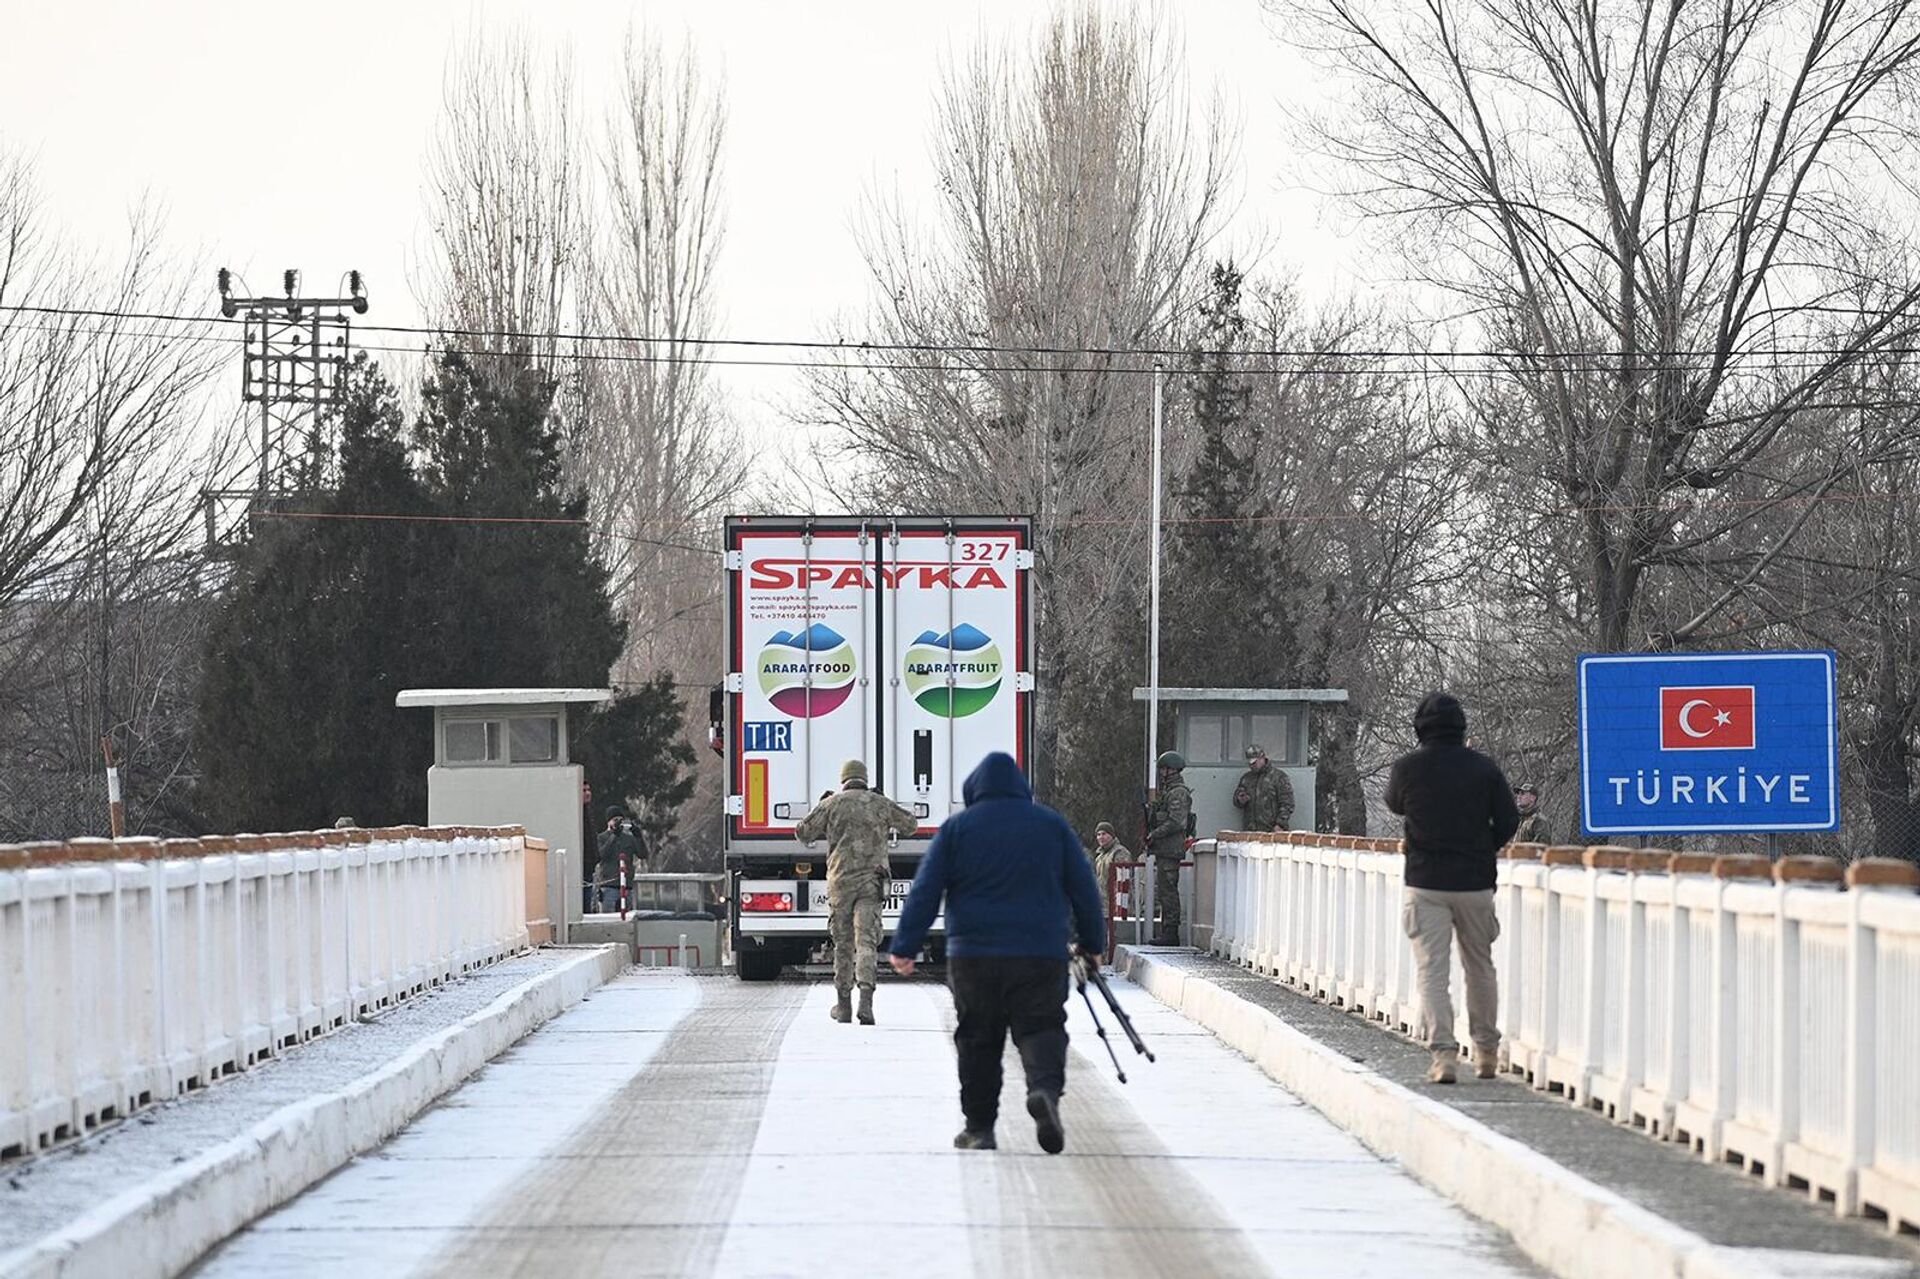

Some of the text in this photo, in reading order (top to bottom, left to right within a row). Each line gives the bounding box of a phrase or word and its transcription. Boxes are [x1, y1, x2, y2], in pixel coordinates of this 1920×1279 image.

[961, 543, 1010, 560] 327
[750, 558, 1007, 590] SPAYKA
[763, 663, 851, 674] ARARATFOOD
[907, 662, 999, 674] ARARATFRUIT
[747, 723, 789, 750] TIR
[1608, 766, 1811, 805] TÜRKİYE
[893, 883, 905, 894] 01
